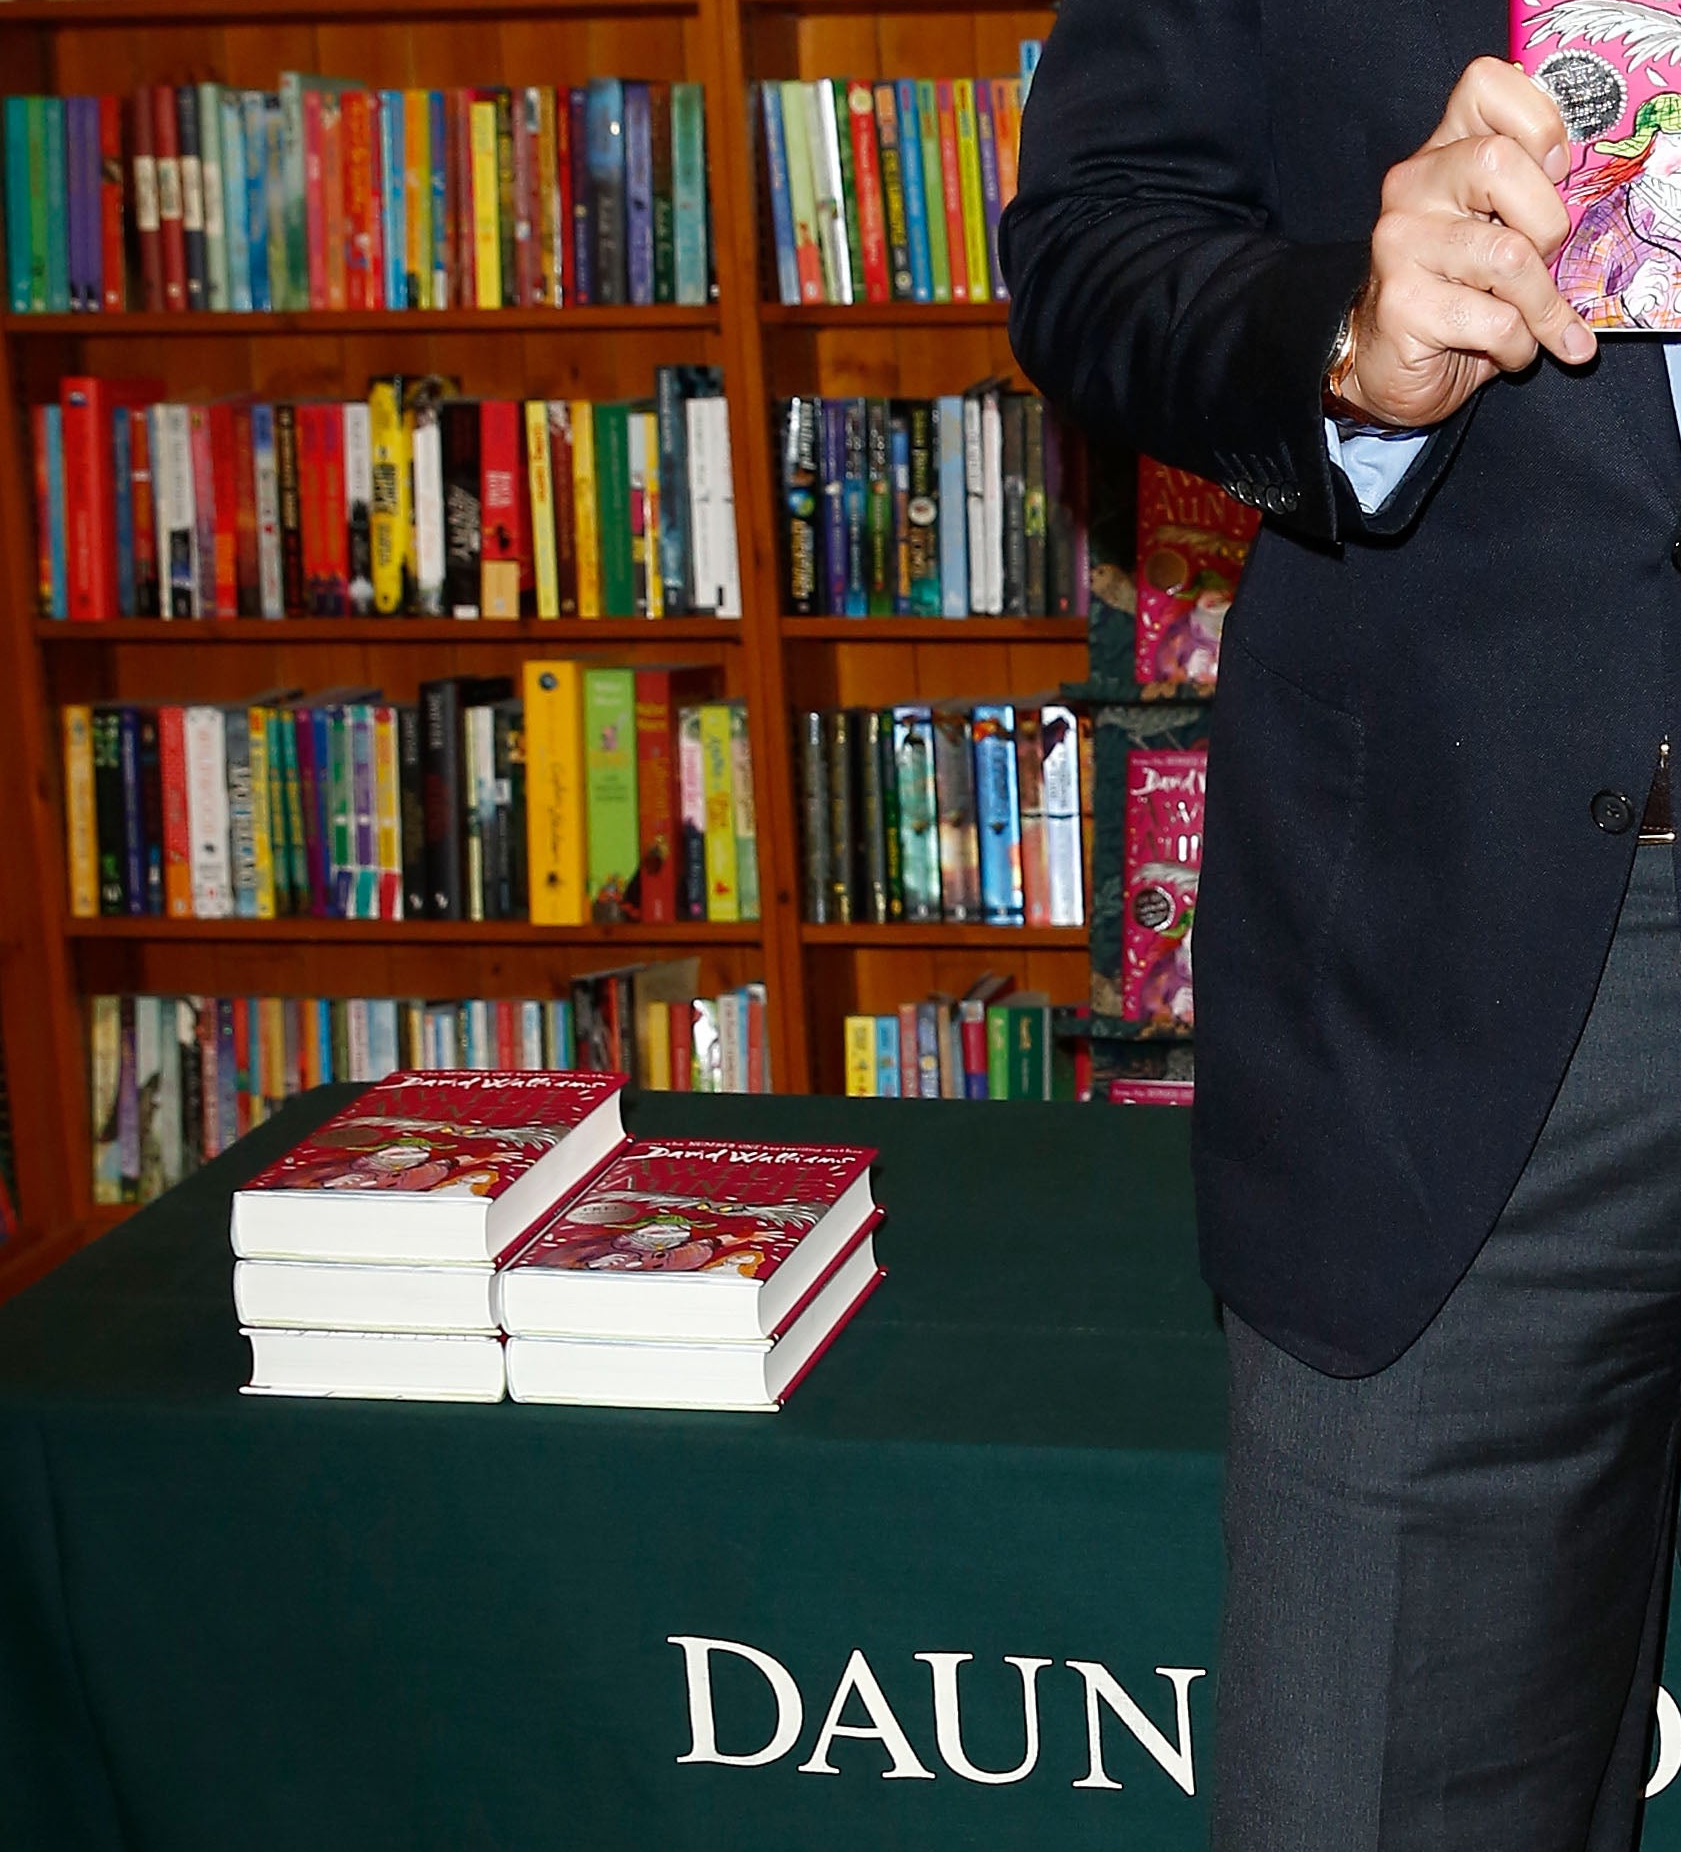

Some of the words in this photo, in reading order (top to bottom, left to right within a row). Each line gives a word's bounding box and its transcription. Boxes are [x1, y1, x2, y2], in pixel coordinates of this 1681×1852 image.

[374, 1076, 481, 1090] David
[481, 1077, 606, 1089] Walliams
[622, 1146, 728, 1163] David
[729, 1150, 855, 1165] Walliams
[665, 1634, 1206, 1795] DAUN
